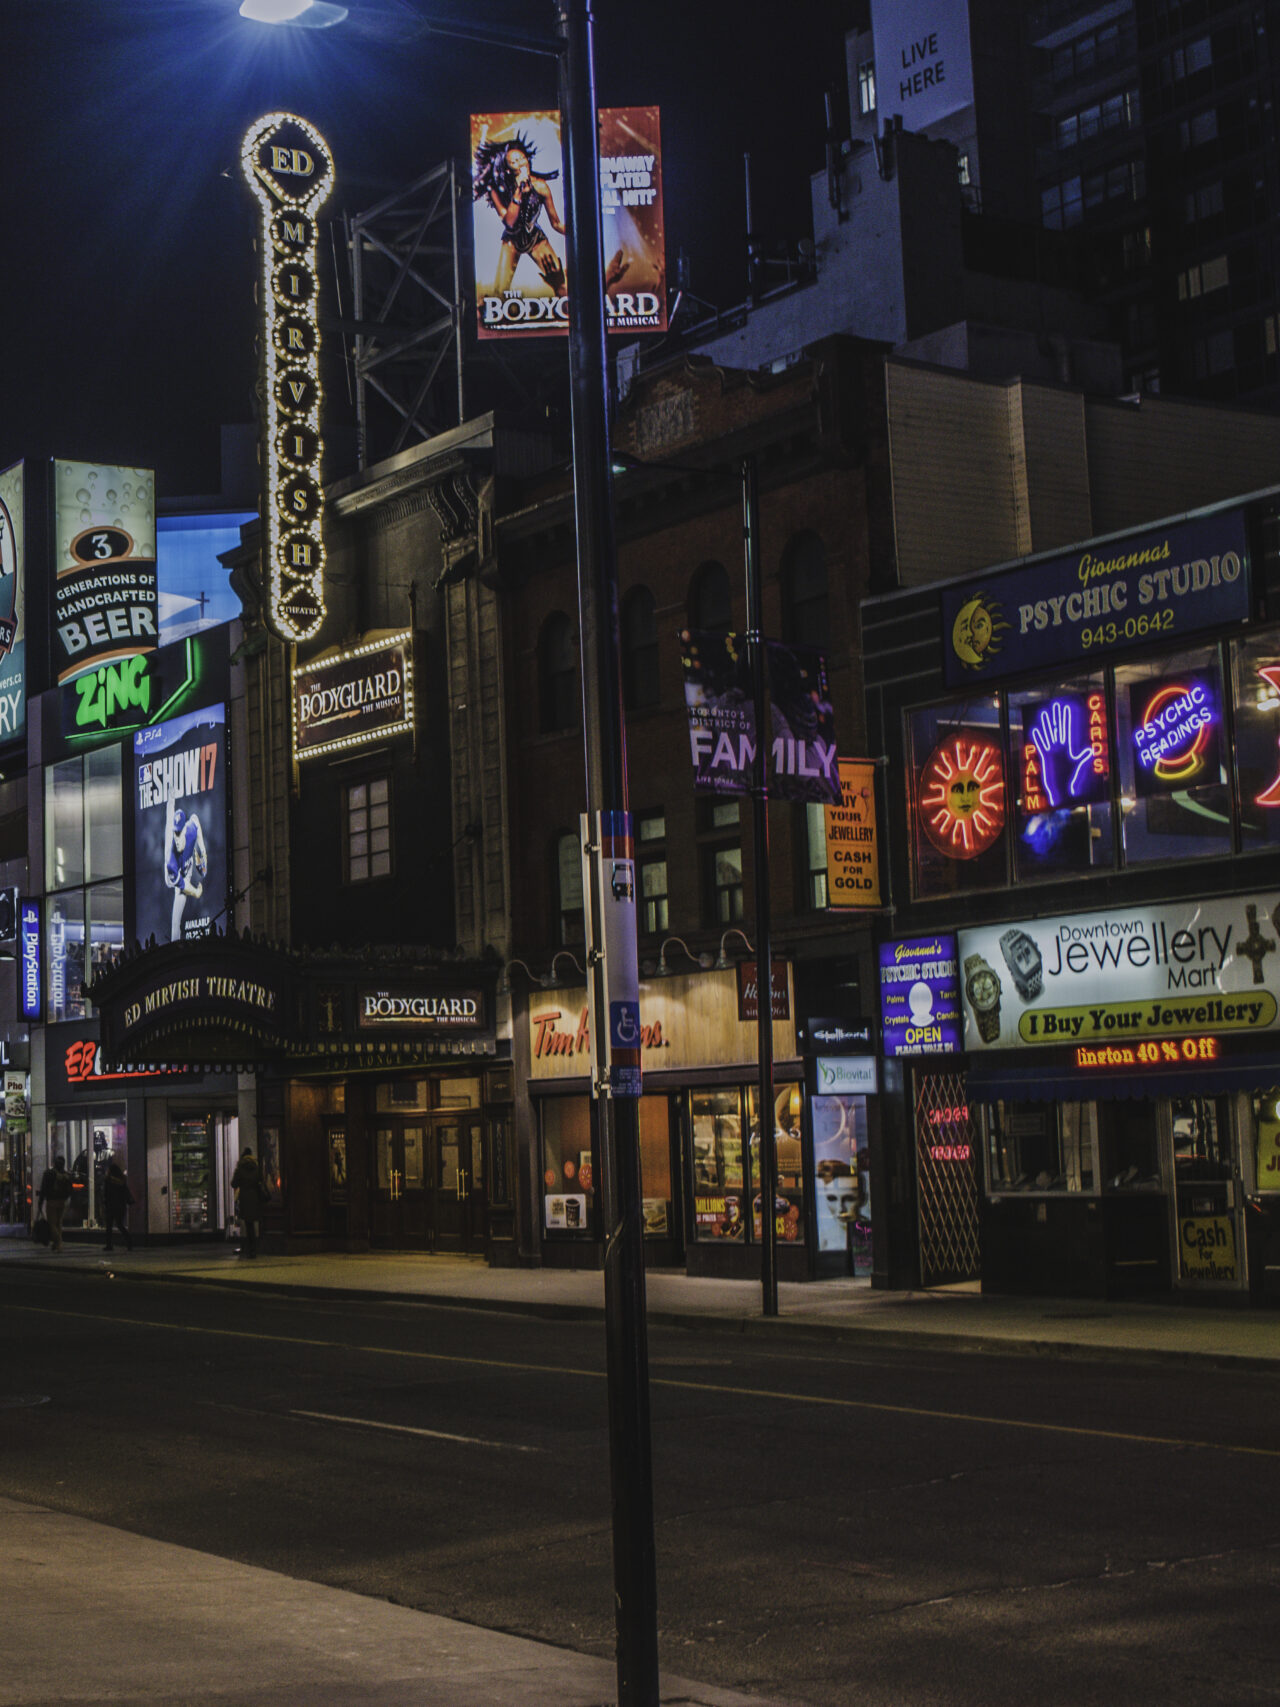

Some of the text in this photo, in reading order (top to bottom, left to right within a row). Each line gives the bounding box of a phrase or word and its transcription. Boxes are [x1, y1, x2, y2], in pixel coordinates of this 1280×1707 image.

[902, 33, 939, 68] LIVE
[899, 61, 945, 101] HERE
[270, 144, 314, 178] ED
[503, 290, 522, 298] THE
[617, 315, 660, 326] MUSICAL
[284, 218, 312, 567] MIRVISH
[91, 534, 112, 559] 3
[56, 572, 156, 601] GENERATIONS OF
[1019, 551, 1241, 634] PSYCHIC STUDIO
[56, 589, 157, 621] HANDCRAFTED
[285, 604, 318, 616] THEATRE
[57, 606, 158, 656] BEER
[1080, 608, 1175, 649] 943-0642
[300, 669, 401, 722] BODYGUARD
[310, 682, 321, 694] THE
[362, 695, 401, 715] THE MUSICAL
[690, 706, 746, 720] TORONTO'S
[1133, 686, 1207, 748] PSYCHIC
[144, 728, 162, 742] PS4
[692, 717, 737, 730] DISTRICT
[1088, 695, 1104, 774] CARDS
[1140, 707, 1213, 767] READINGS
[690, 730, 838, 779] FAMILY
[1023, 744, 1040, 810] PALM
[139, 783, 154, 810] THE
[829, 810, 862, 822] YOUR
[828, 826, 873, 842] JEWELLERY
[834, 850, 872, 863] CASH
[842, 865, 863, 875] FOR
[834, 877, 873, 890] GOLD
[1059, 919, 1144, 943] Downtown
[1048, 922, 1233, 976] Jewellery
[23, 932, 39, 1010] PlayStation
[880, 962, 921, 984] PSYCHIC
[1167, 964, 1218, 990] Mart
[123, 976, 277, 1029] ED MIRVISH THEATRE
[364, 996, 477, 1017] BODYGUARD
[449, 1016, 477, 1024] MUSICAL
[1043, 1013, 1086, 1037] Buy
[1089, 1007, 1142, 1031] Your
[1148, 1000, 1264, 1029] Jewellery
[533, 1011, 576, 1058] Tim
[905, 1026, 942, 1045] OPEN
[1136, 1043, 1159, 1062] 40
[1161, 1041, 1179, 1060] %
[1182, 1037, 1217, 1060] Off
[7, 1081, 23, 1090] Pho
[836, 1066, 872, 1080] Biovital
[1182, 1219, 1227, 1248] Cash
